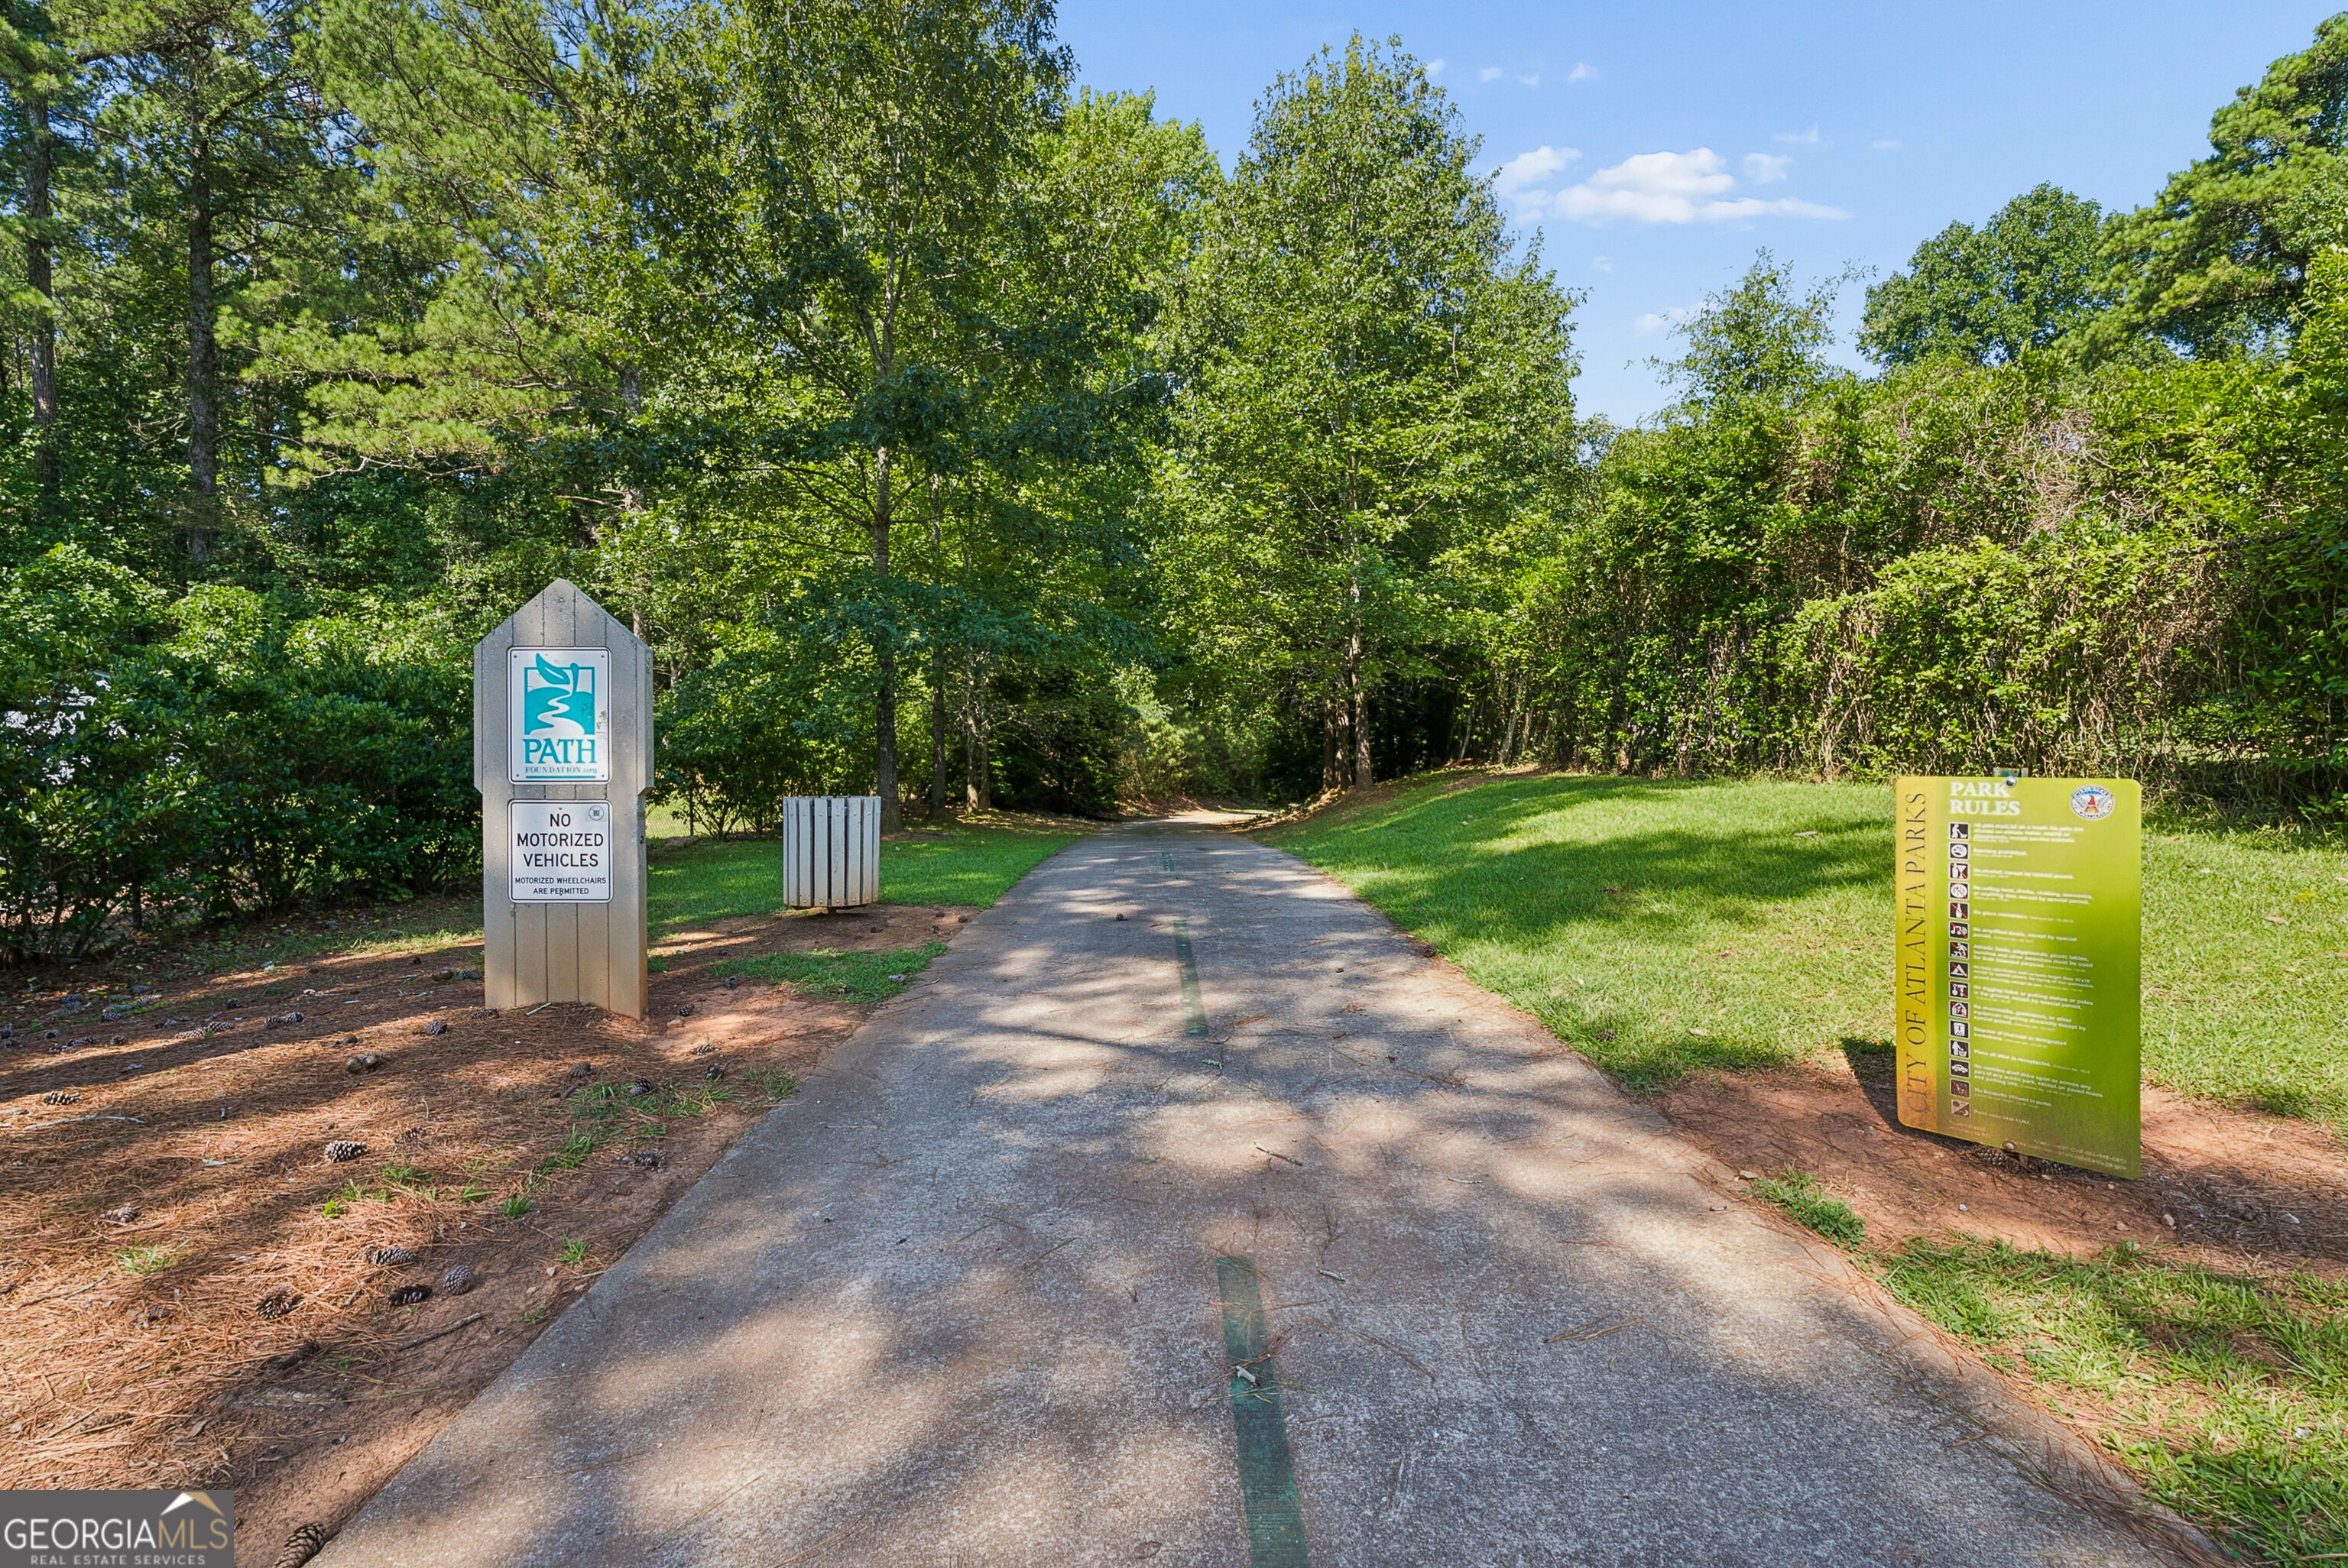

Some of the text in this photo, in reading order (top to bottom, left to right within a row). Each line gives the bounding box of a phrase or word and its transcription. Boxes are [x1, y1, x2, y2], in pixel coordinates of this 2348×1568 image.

[522, 738, 598, 764] PATH
[1949, 781, 2011, 798] PARK
[1949, 799, 2021, 815] RULES
[550, 813, 571, 827] NO
[517, 833, 604, 847] MOTORIZED
[523, 854, 598, 867] VEHICLES
[1905, 792, 1928, 1113] CITY OF ATLANTA PARKS
